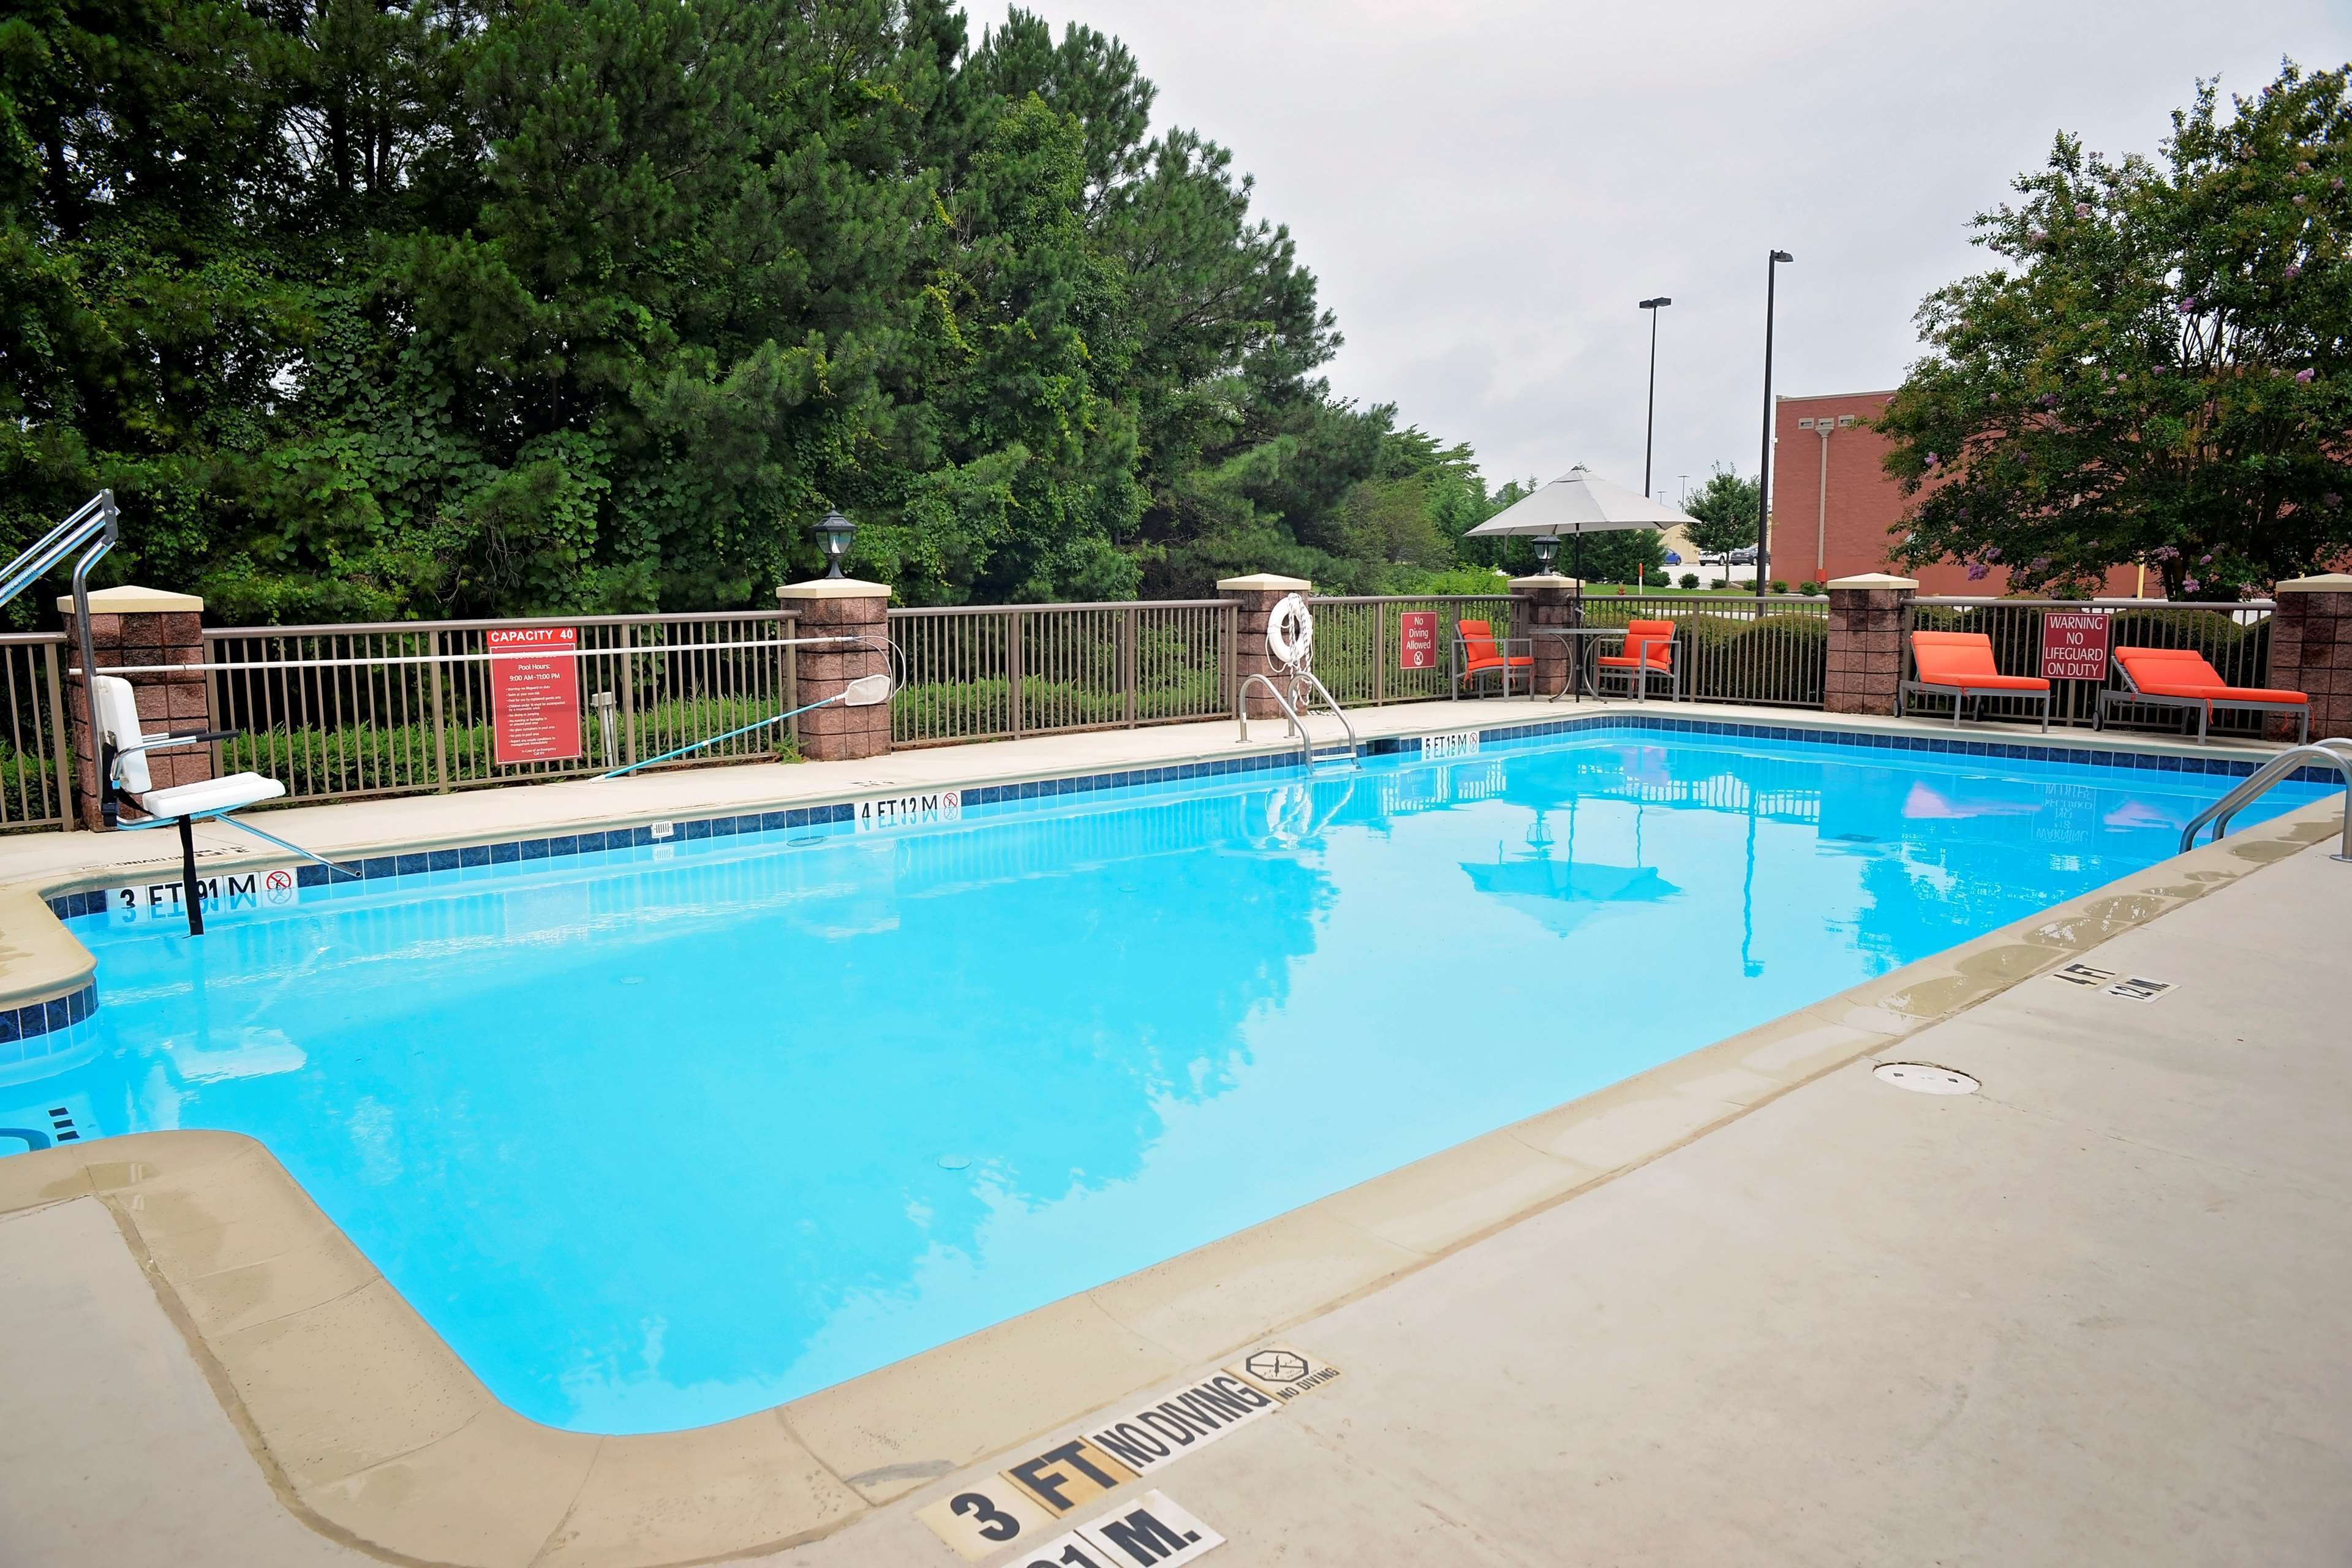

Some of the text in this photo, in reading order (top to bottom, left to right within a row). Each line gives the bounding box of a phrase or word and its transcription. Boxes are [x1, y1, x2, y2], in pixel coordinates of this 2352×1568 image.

[1414, 616, 1423, 625] No
[2049, 616, 2103, 630] WARNING
[491, 628, 573, 643] CAPACITY 40
[1409, 628, 1428, 639] Diving
[2066, 632, 2084, 645] NO
[1406, 639, 1431, 650] Allowed
[2045, 647, 2103, 661] LIFEGUARD
[2048, 662, 2099, 676] ON DUTY
[861, 802, 871, 819] 4
[922, 794, 938, 812] M
[120, 888, 135, 910] 3
[228, 874, 256, 897] M
[2053, 963, 2116, 985] 4 FT
[1276, 1386, 1300, 1400] NO
[1295, 1367, 1341, 1391] DIVING
[950, 1376, 1273, 1542] 3 FT NO DIVING
[1099, 1508, 1202, 1568] M.
